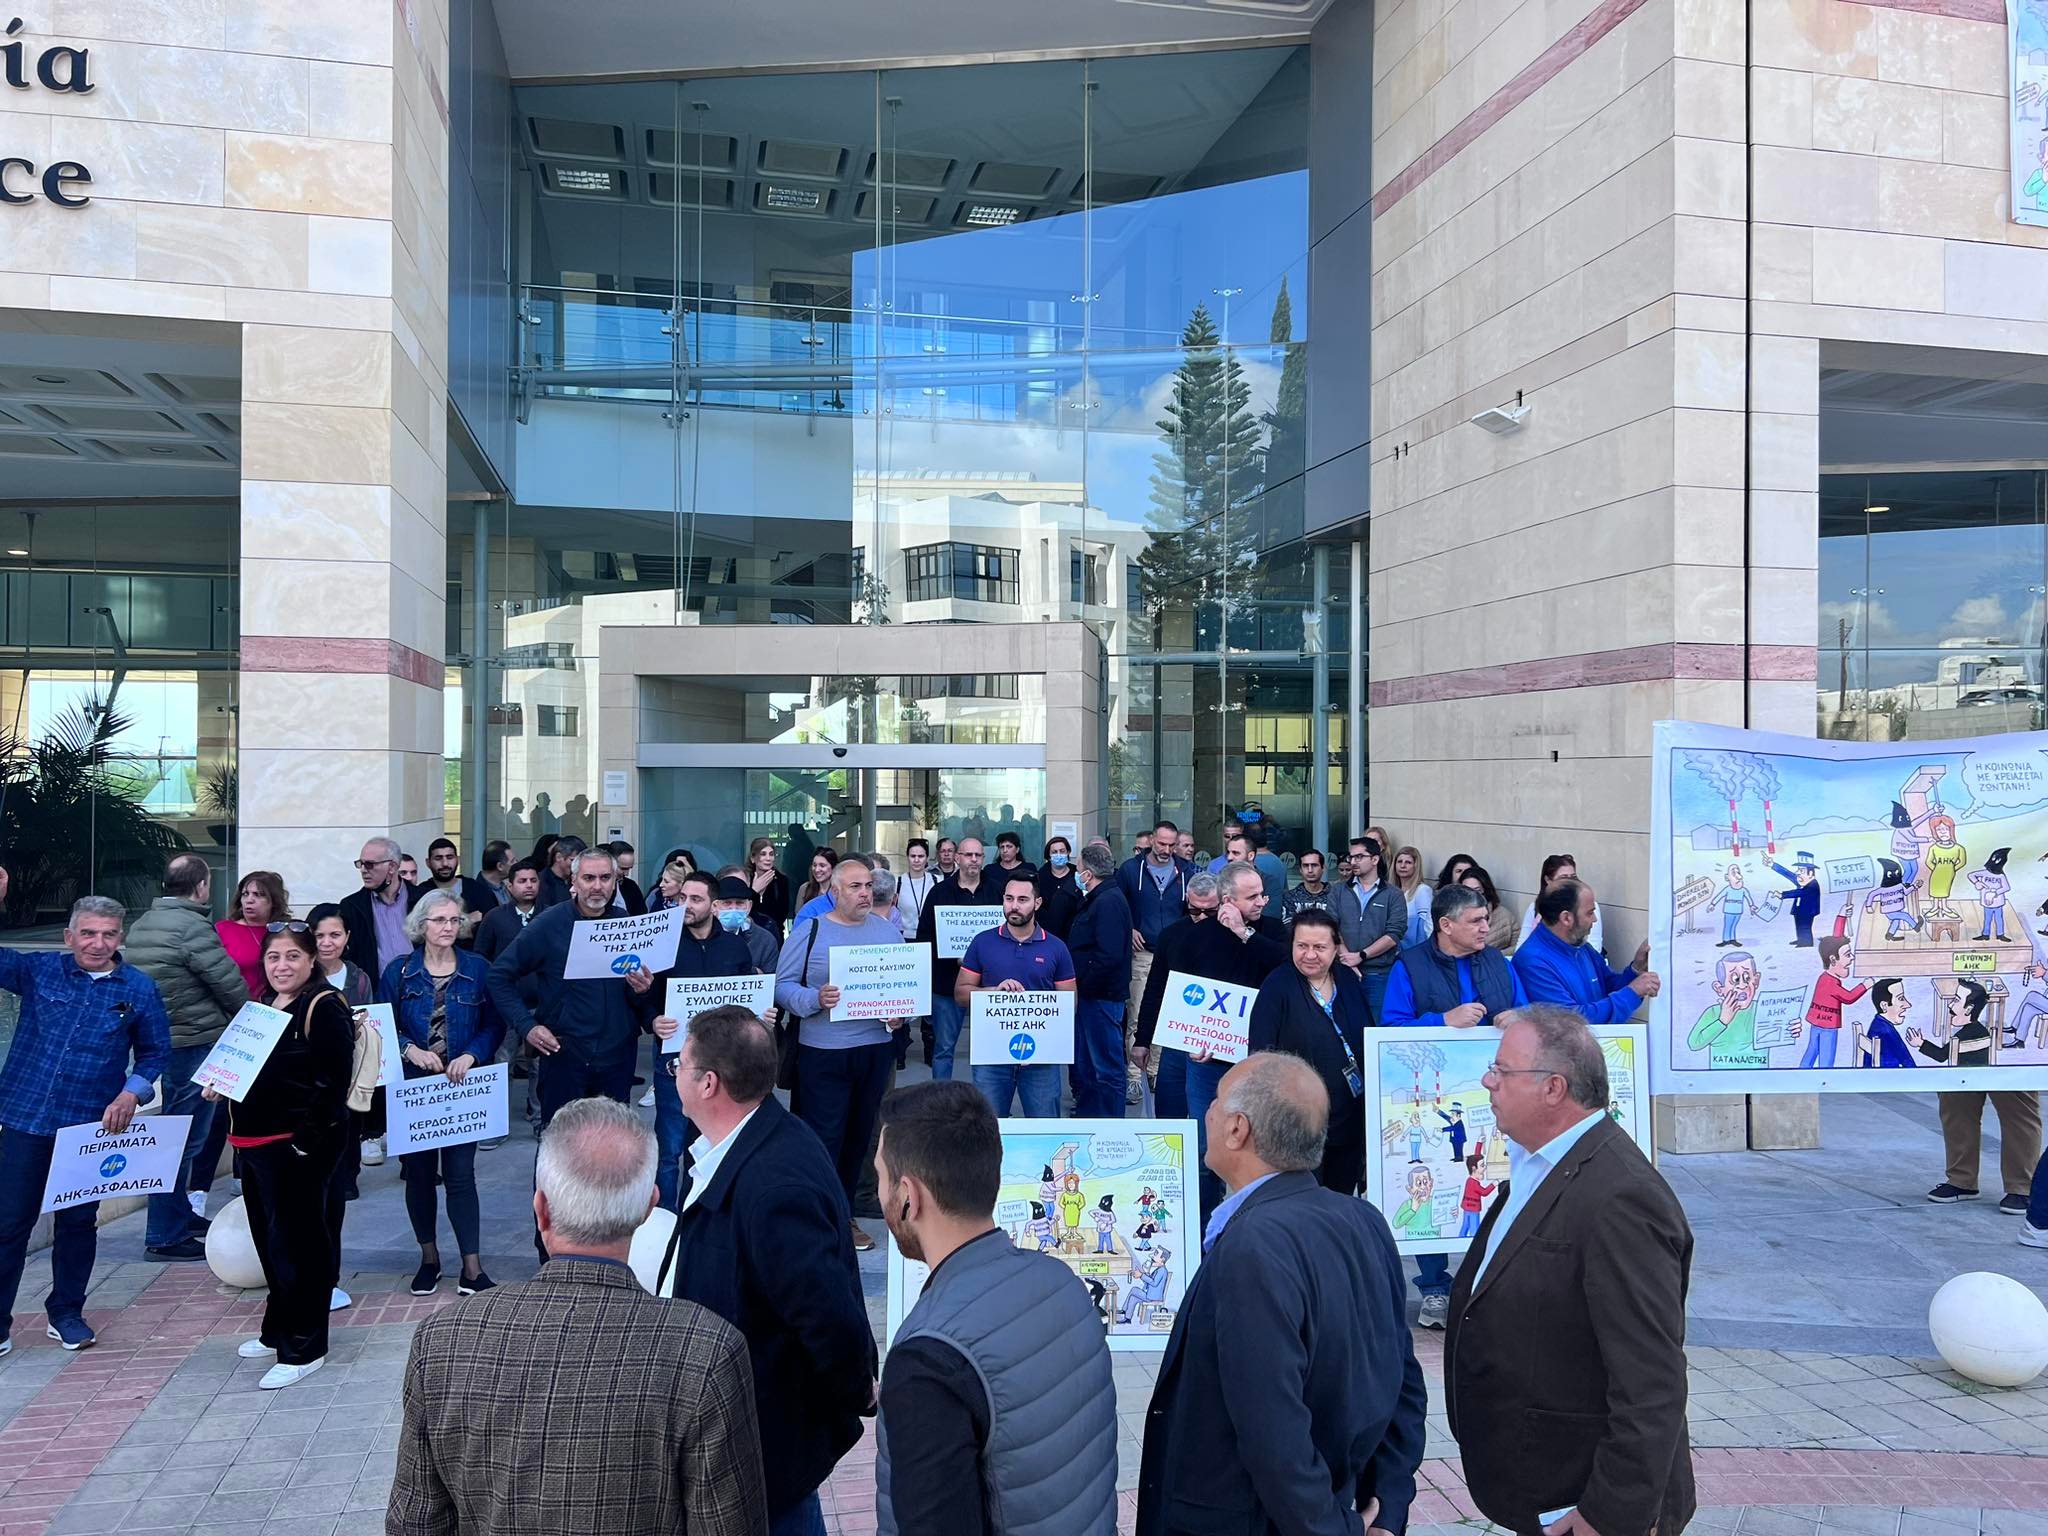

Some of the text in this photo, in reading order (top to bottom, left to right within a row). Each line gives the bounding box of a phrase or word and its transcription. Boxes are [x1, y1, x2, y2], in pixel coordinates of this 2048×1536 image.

[0, 17, 96, 95] ία
[0, 157, 94, 210] ce
[1834, 862, 1866, 873] ΣΩΣΤΕ
[1833, 876, 1870, 887] ΤΗΝ ΑΗΚ
[594, 912, 670, 931] ΤΕΡΜΑ ΣΤΗΝ
[590, 924, 669, 942] ΚΑΤΑΣΤΡΟΦΗ
[603, 939, 654, 952] ΤΗΣ ΑΗΚ
[849, 946, 891, 955] ΑΥΞΗΜΕΝΟΙ
[677, 980, 764, 993] ΣΕΒΑΣΜΟΣ ΣΤΙΣ
[844, 983, 893, 991] ΑΚΡΙΒΟΤΕΡΟ
[686, 994, 753, 1006] ΣΥΛΛΟΓΙΚΕΣ
[847, 999, 915, 1008] ΟΥΡΑΝΟΚΑΤΕΒΑΤΑ
[988, 994, 1057, 1003] ΤΕΡΜΑ ΣΤΗΝ
[986, 1008, 1059, 1017] ΚΑΤΑΣΤΡΟΦΗ
[1768, 1008, 1787, 1017] ΑΗΚ
[1000, 1020, 1046, 1030] ΤΗΣ ΑΗΚ
[1200, 1015, 1230, 1028] ΤΡΙΤΟ
[1168, 1020, 1249, 1045] ΣΥΝΤΑΞΙΟΔΟΤΙΚ
[1184, 1036, 1236, 1056] ΣΤΗΝ ΑΗΚ
[1713, 1056, 1766, 1064] ΚΑΤΑΝΑΛΩΤΗΣ
[396, 1072, 499, 1098] ΕΚΣΥΓΧΡΟΝΙΣΜΟΣ
[404, 1086, 492, 1108] ΤΗΣ ΔΕΚΕΛΕΙΑΣ
[409, 1110, 487, 1131] ΚΕΡΔΟΣ ΣΤΟΝ
[410, 1121, 486, 1142] ΚΑΤΑΝΑΛΩΤΗ
[79, 1136, 156, 1155] ΠΕΙΡΑΜΑΤΑ
[53, 1178, 163, 1205] ΑΗΚ=ΑΣΦΑΛΕΙΑ
